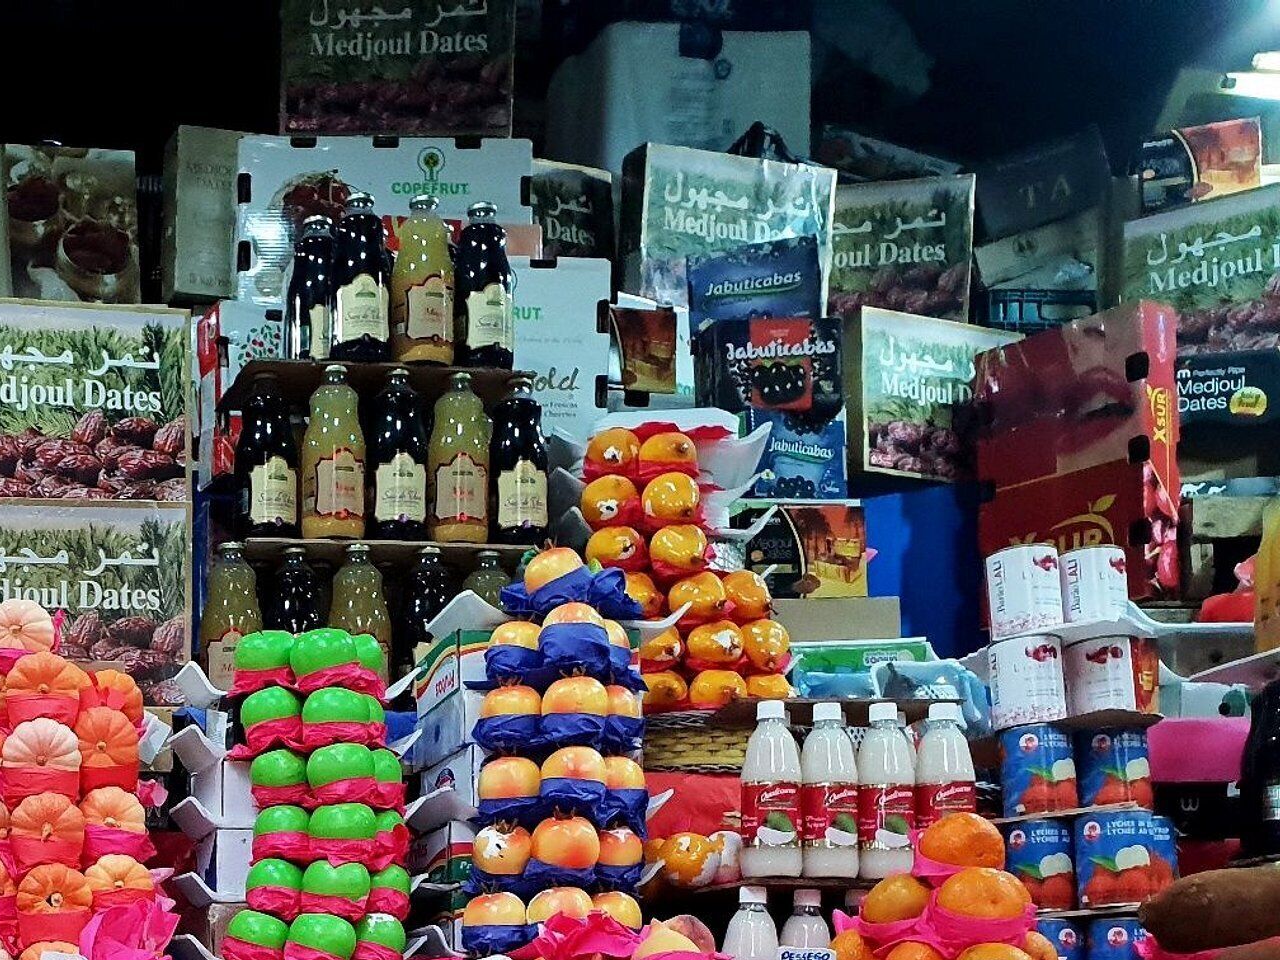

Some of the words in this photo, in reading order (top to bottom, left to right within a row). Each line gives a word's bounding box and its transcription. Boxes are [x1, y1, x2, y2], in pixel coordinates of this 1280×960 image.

[310, 31, 411, 61] Medjoul
[420, 30, 489, 53] Dates
[391, 181, 469, 196] COPEFRUT
[546, 218, 596, 248] Dates
[663, 206, 748, 243] Medjoul
[879, 241, 947, 267] Dates
[705, 270, 802, 296] Jabuticabas
[1149, 248, 1264, 295] Medjoul
[88, 346, 160, 376] تمر
[725, 337, 836, 362] Jabuticabas
[83, 379, 164, 415] Dates
[881, 376, 953, 406] Medjoul
[1177, 375, 1245, 396] Medjoul
[1177, 396, 1227, 412] Dates
[768, 437, 835, 459] Jabuticabas
[82, 543, 160, 577] تمر
[77, 580, 161, 611] Dates
